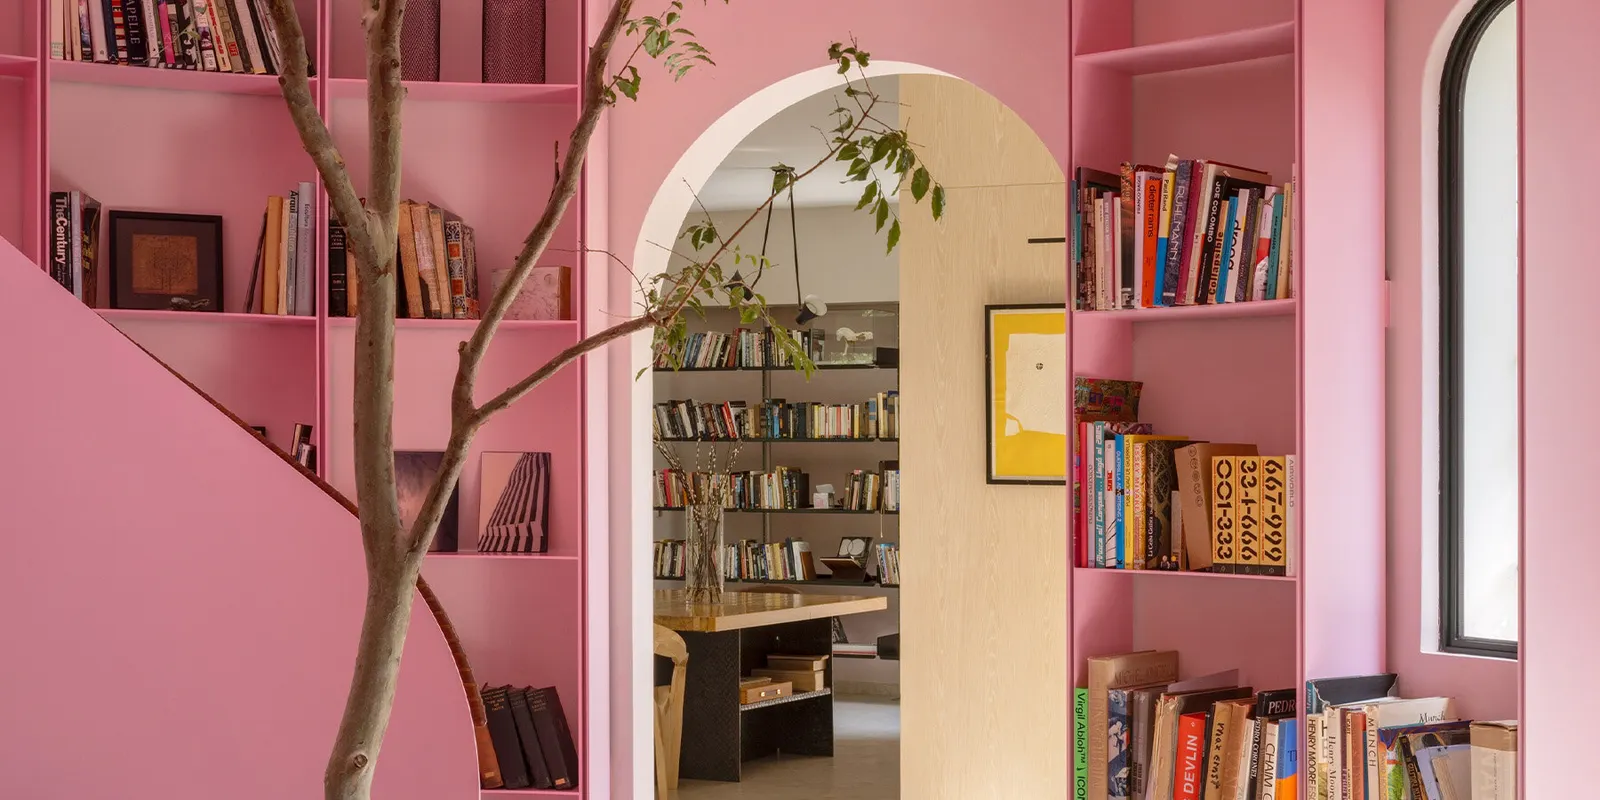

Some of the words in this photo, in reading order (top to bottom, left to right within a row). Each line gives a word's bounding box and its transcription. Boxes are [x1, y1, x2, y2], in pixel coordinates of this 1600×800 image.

[290, 190, 298, 214] Arqui
[1148, 184, 1156, 212] dieter
[1213, 181, 1221, 198] JOE
[1169, 185, 1185, 260] RUHLMANN
[1207, 199, 1218, 243] COLOMBO
[1208, 231, 1223, 296] Collapsible
[1217, 459, 1232, 560] 001-333
[1240, 460, 1258, 560] 334-666
[1264, 459, 1282, 562] 667-999
[1075, 692, 1086, 720] Virgil
[1268, 700, 1297, 714] PEDR
[1254, 716, 1262, 742] PEDRO
[1308, 719, 1316, 751] HENRY
[1368, 718, 1376, 768] MUNCH
[1184, 735, 1198, 794] DEVLIN
[1250, 742, 1258, 780] CORONEL
[1264, 743, 1276, 788] CHAIM
[1308, 751, 1316, 785] MOORE
[1328, 736, 1336, 766] Henry
